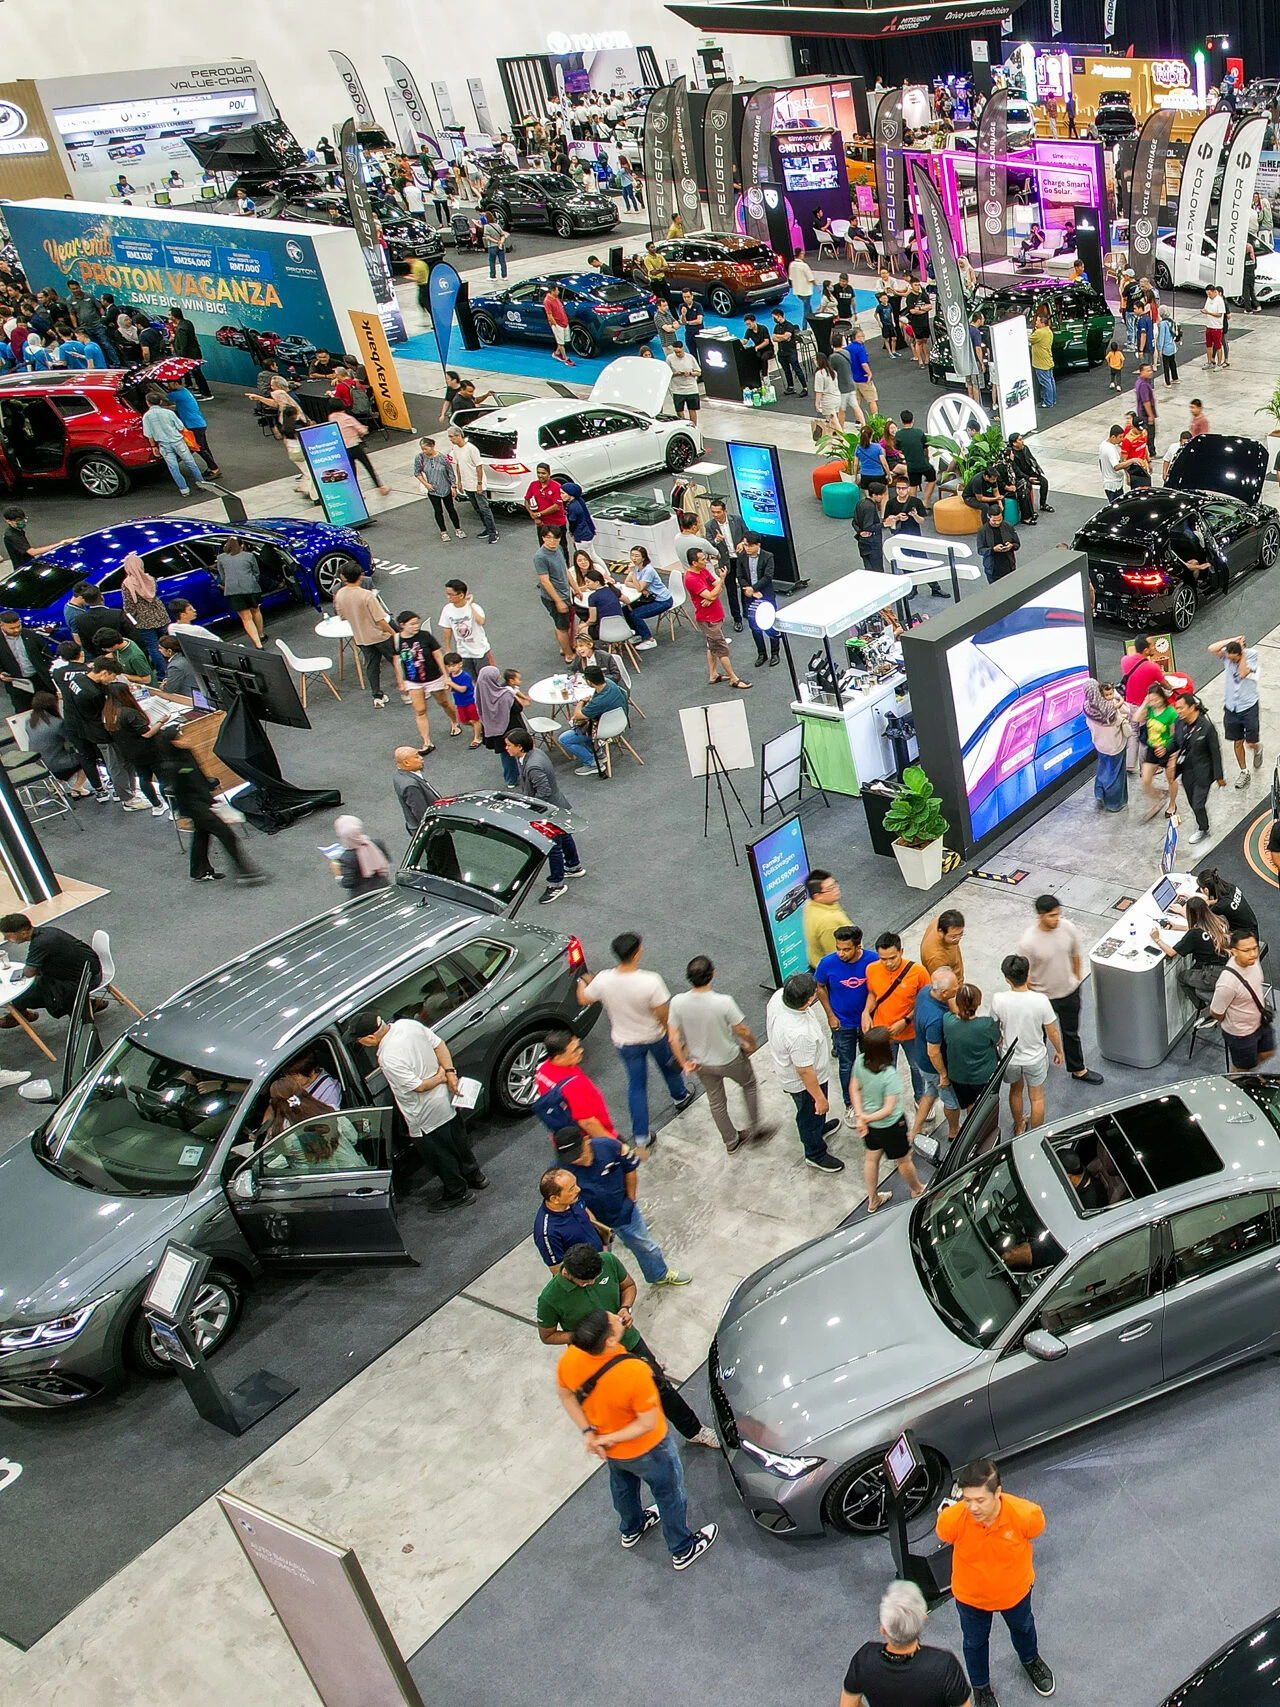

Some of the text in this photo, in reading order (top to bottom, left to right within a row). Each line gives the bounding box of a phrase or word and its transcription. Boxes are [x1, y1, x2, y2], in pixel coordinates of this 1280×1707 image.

[945, 7, 1010, 20] Drive your Ambition
[1106, 0, 1115, 26] TRAP
[897, 22, 919, 31] MOTORS
[170, 76, 256, 90] VALUE-CHAIN
[191, 66, 253, 79] PERODUA
[753, 115, 762, 154] CARRIAGE
[989, 121, 997, 163] CARRIAGE
[654, 136, 666, 218] PEUGEOT
[714, 133, 727, 216] PEUGEOT
[1043, 179, 1090, 188] Charge Smarte
[1142, 190, 1150, 216] CYCLE
[1146, 139, 1158, 182] CARRIAGE
[886, 145, 896, 232] PEUGEOT
[1185, 167, 1205, 261] LEAPMOTOR
[1226, 178, 1244, 276] LEAPMOTOR
[352, 183, 383, 277] PEUGEOT
[79, 261, 284, 309] PROTON VAGANZA
[131, 292, 158, 305] SAVE
[182, 299, 204, 311] WIN
[205, 302, 228, 315] BIG!
[361, 319, 391, 399] Maybank
[761, 852, 784, 870] Family?
[763, 853, 796, 877] Volkswagen
[1230, 886, 1243, 910] CREW
[778, 935, 784, 945] 5
[780, 948, 786, 958] 5
